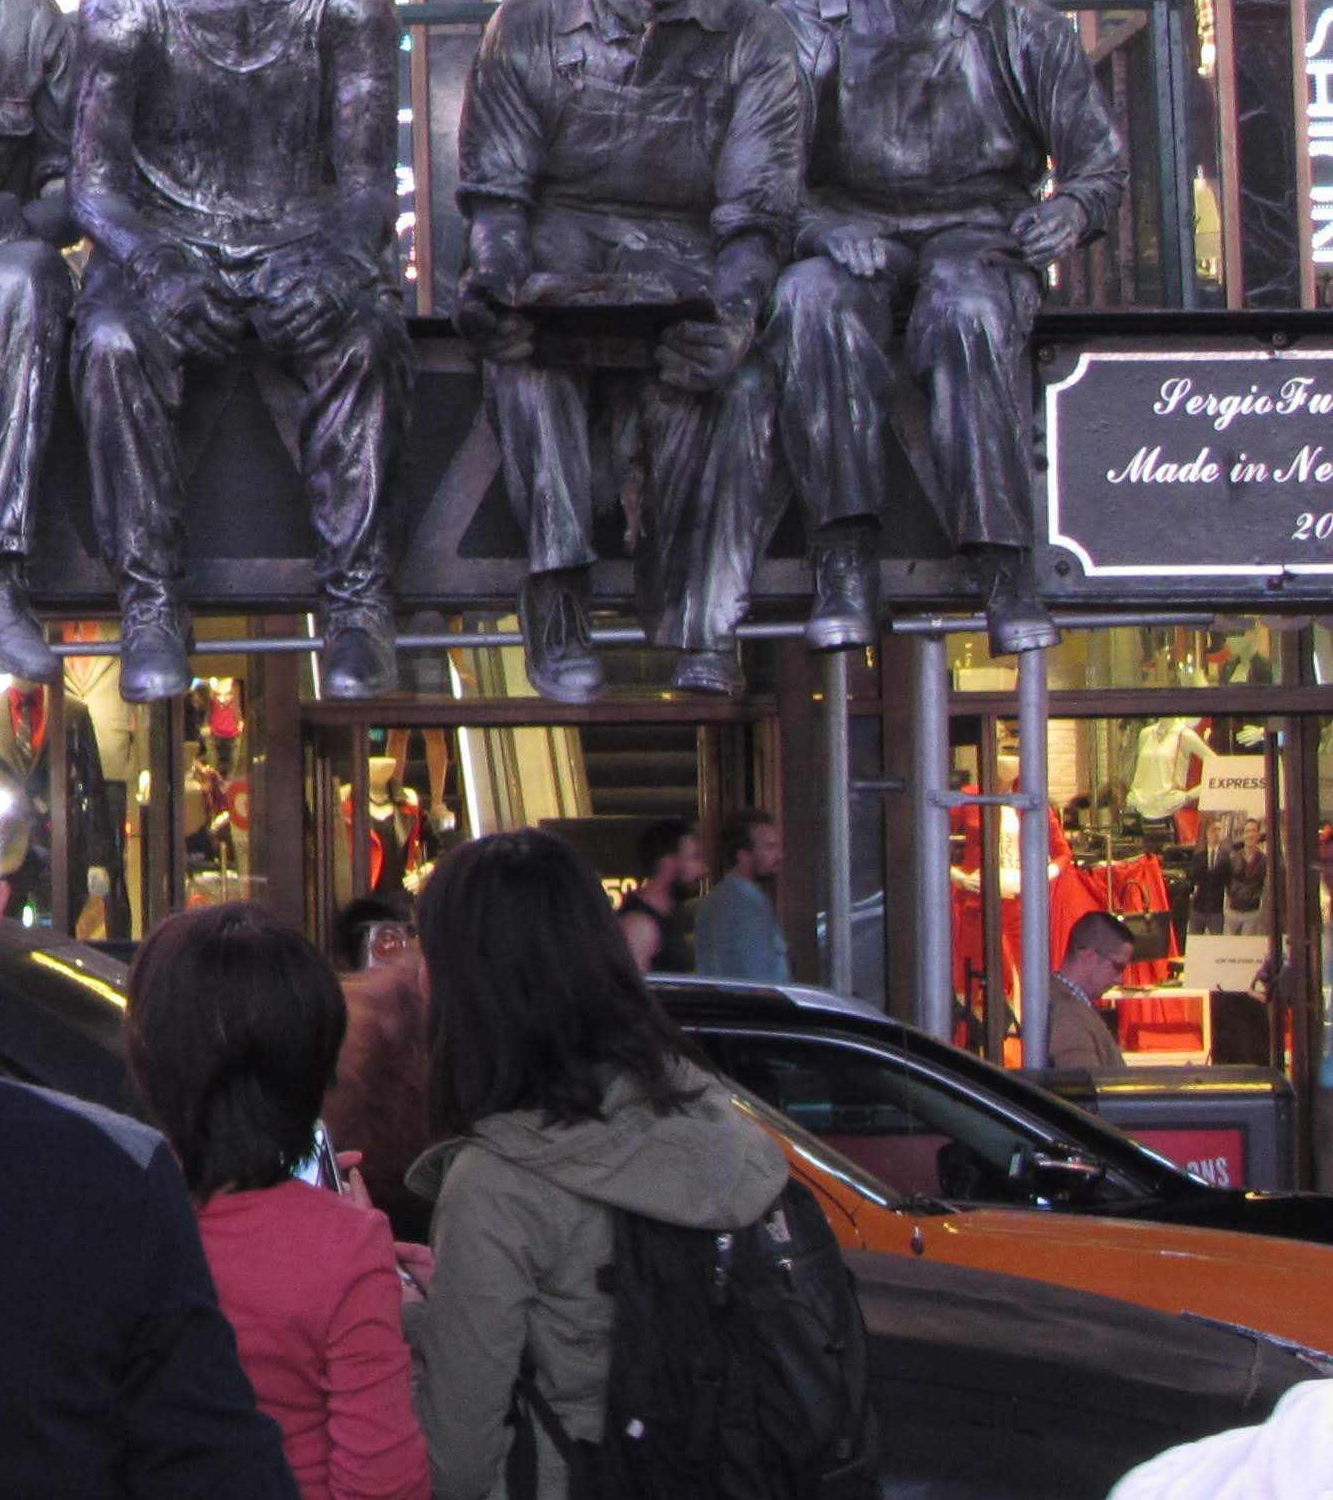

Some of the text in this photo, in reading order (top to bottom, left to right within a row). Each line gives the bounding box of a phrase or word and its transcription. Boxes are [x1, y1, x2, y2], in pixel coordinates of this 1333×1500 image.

[1106, 446, 1220, 484] Made
[1230, 453, 1266, 483] in
[1208, 777, 1268, 790] EXPRESS
